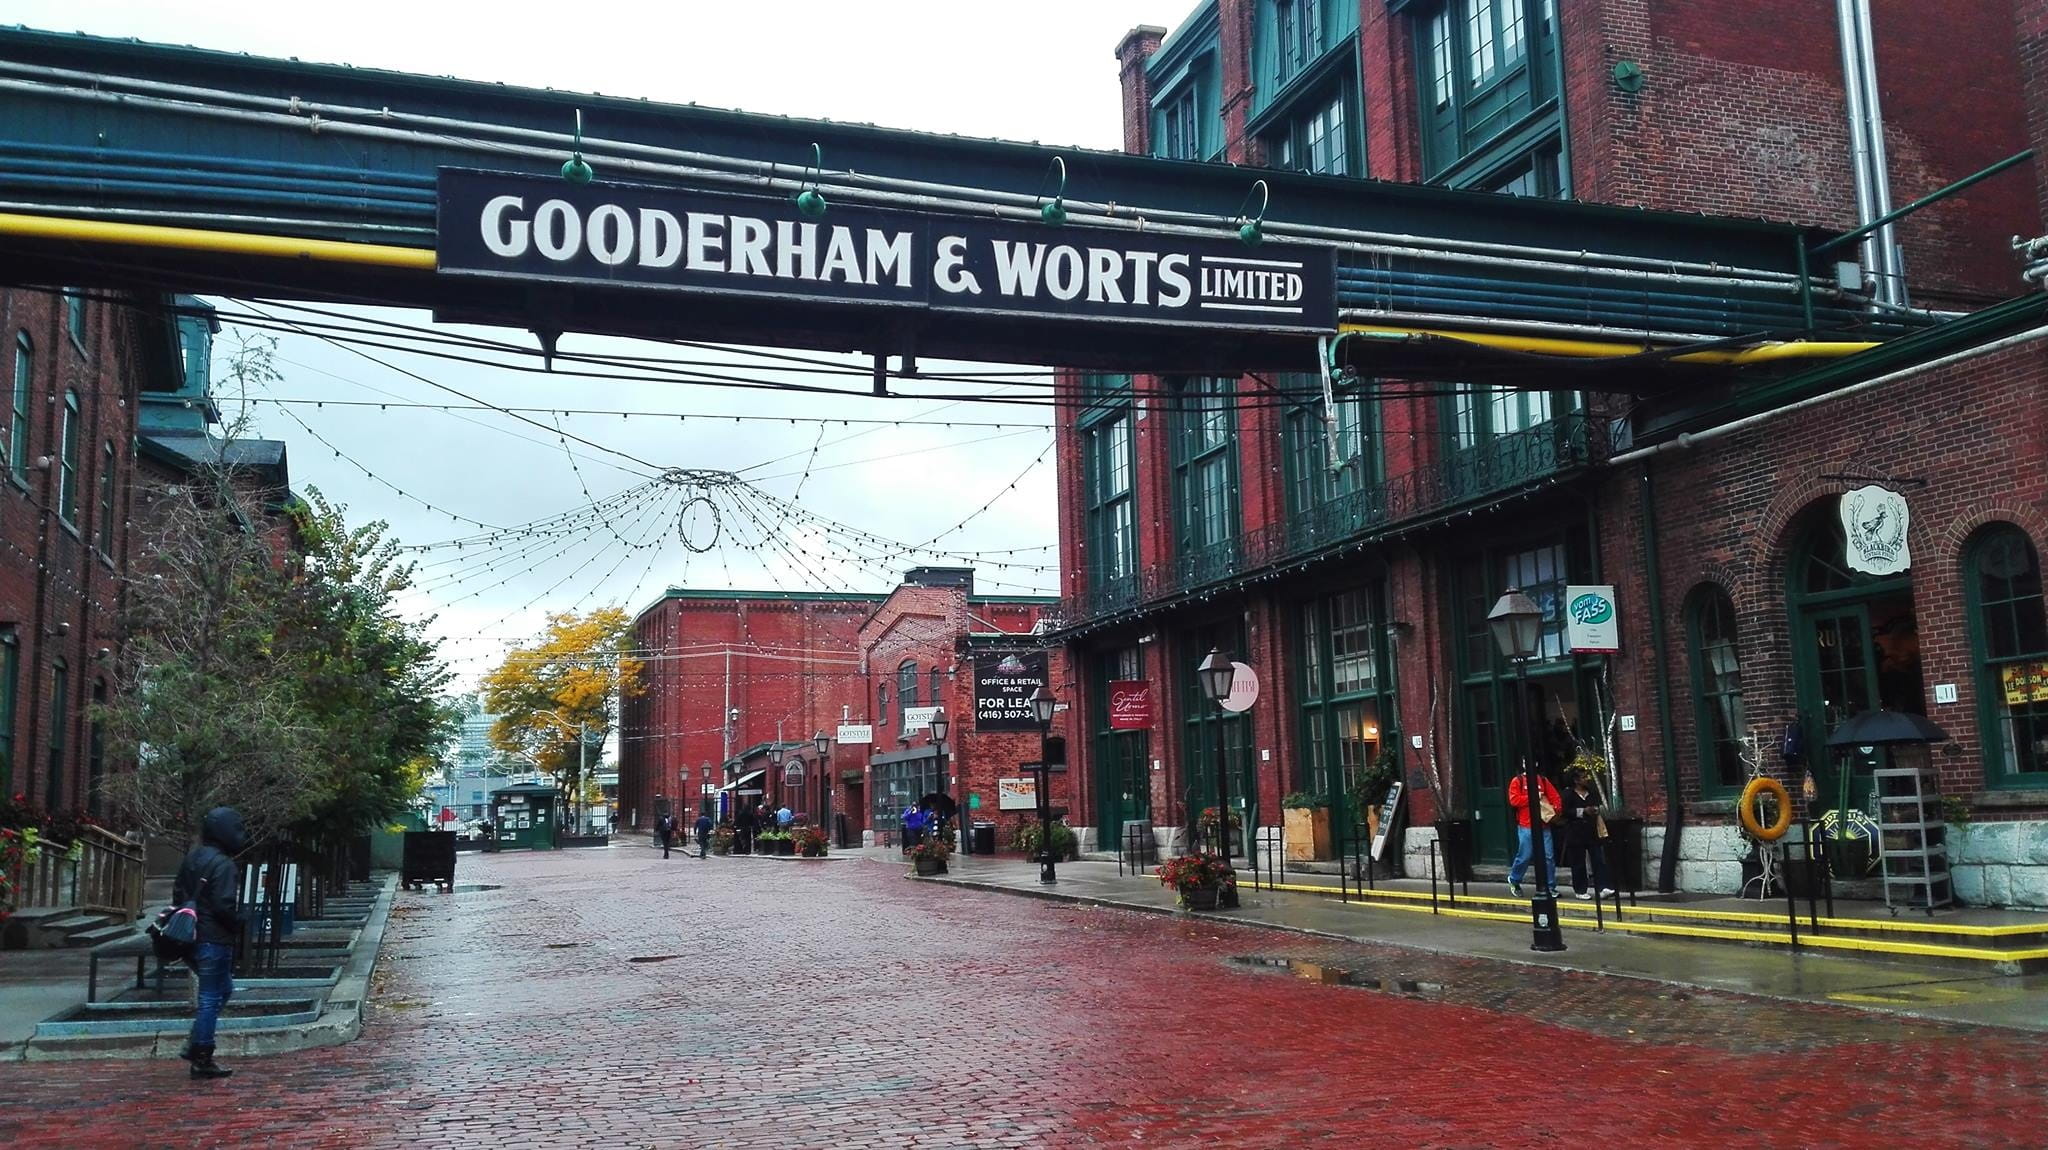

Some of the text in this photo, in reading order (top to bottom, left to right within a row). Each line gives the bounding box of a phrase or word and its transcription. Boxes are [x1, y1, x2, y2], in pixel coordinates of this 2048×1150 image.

[480, 195, 1303, 308] GOODERHAM & WORTS LIMITED
[1574, 597, 1590, 610] vom
[1575, 599, 1606, 624] FASS
[981, 678, 1041, 686] OFFICE & RETAIL
[2015, 675, 2042, 686] DOON
[1944, 687, 1954, 699] 11
[978, 698, 1005, 709] FOR
[978, 710, 1002, 720] (416)
[1626, 717, 1635, 728] 13
